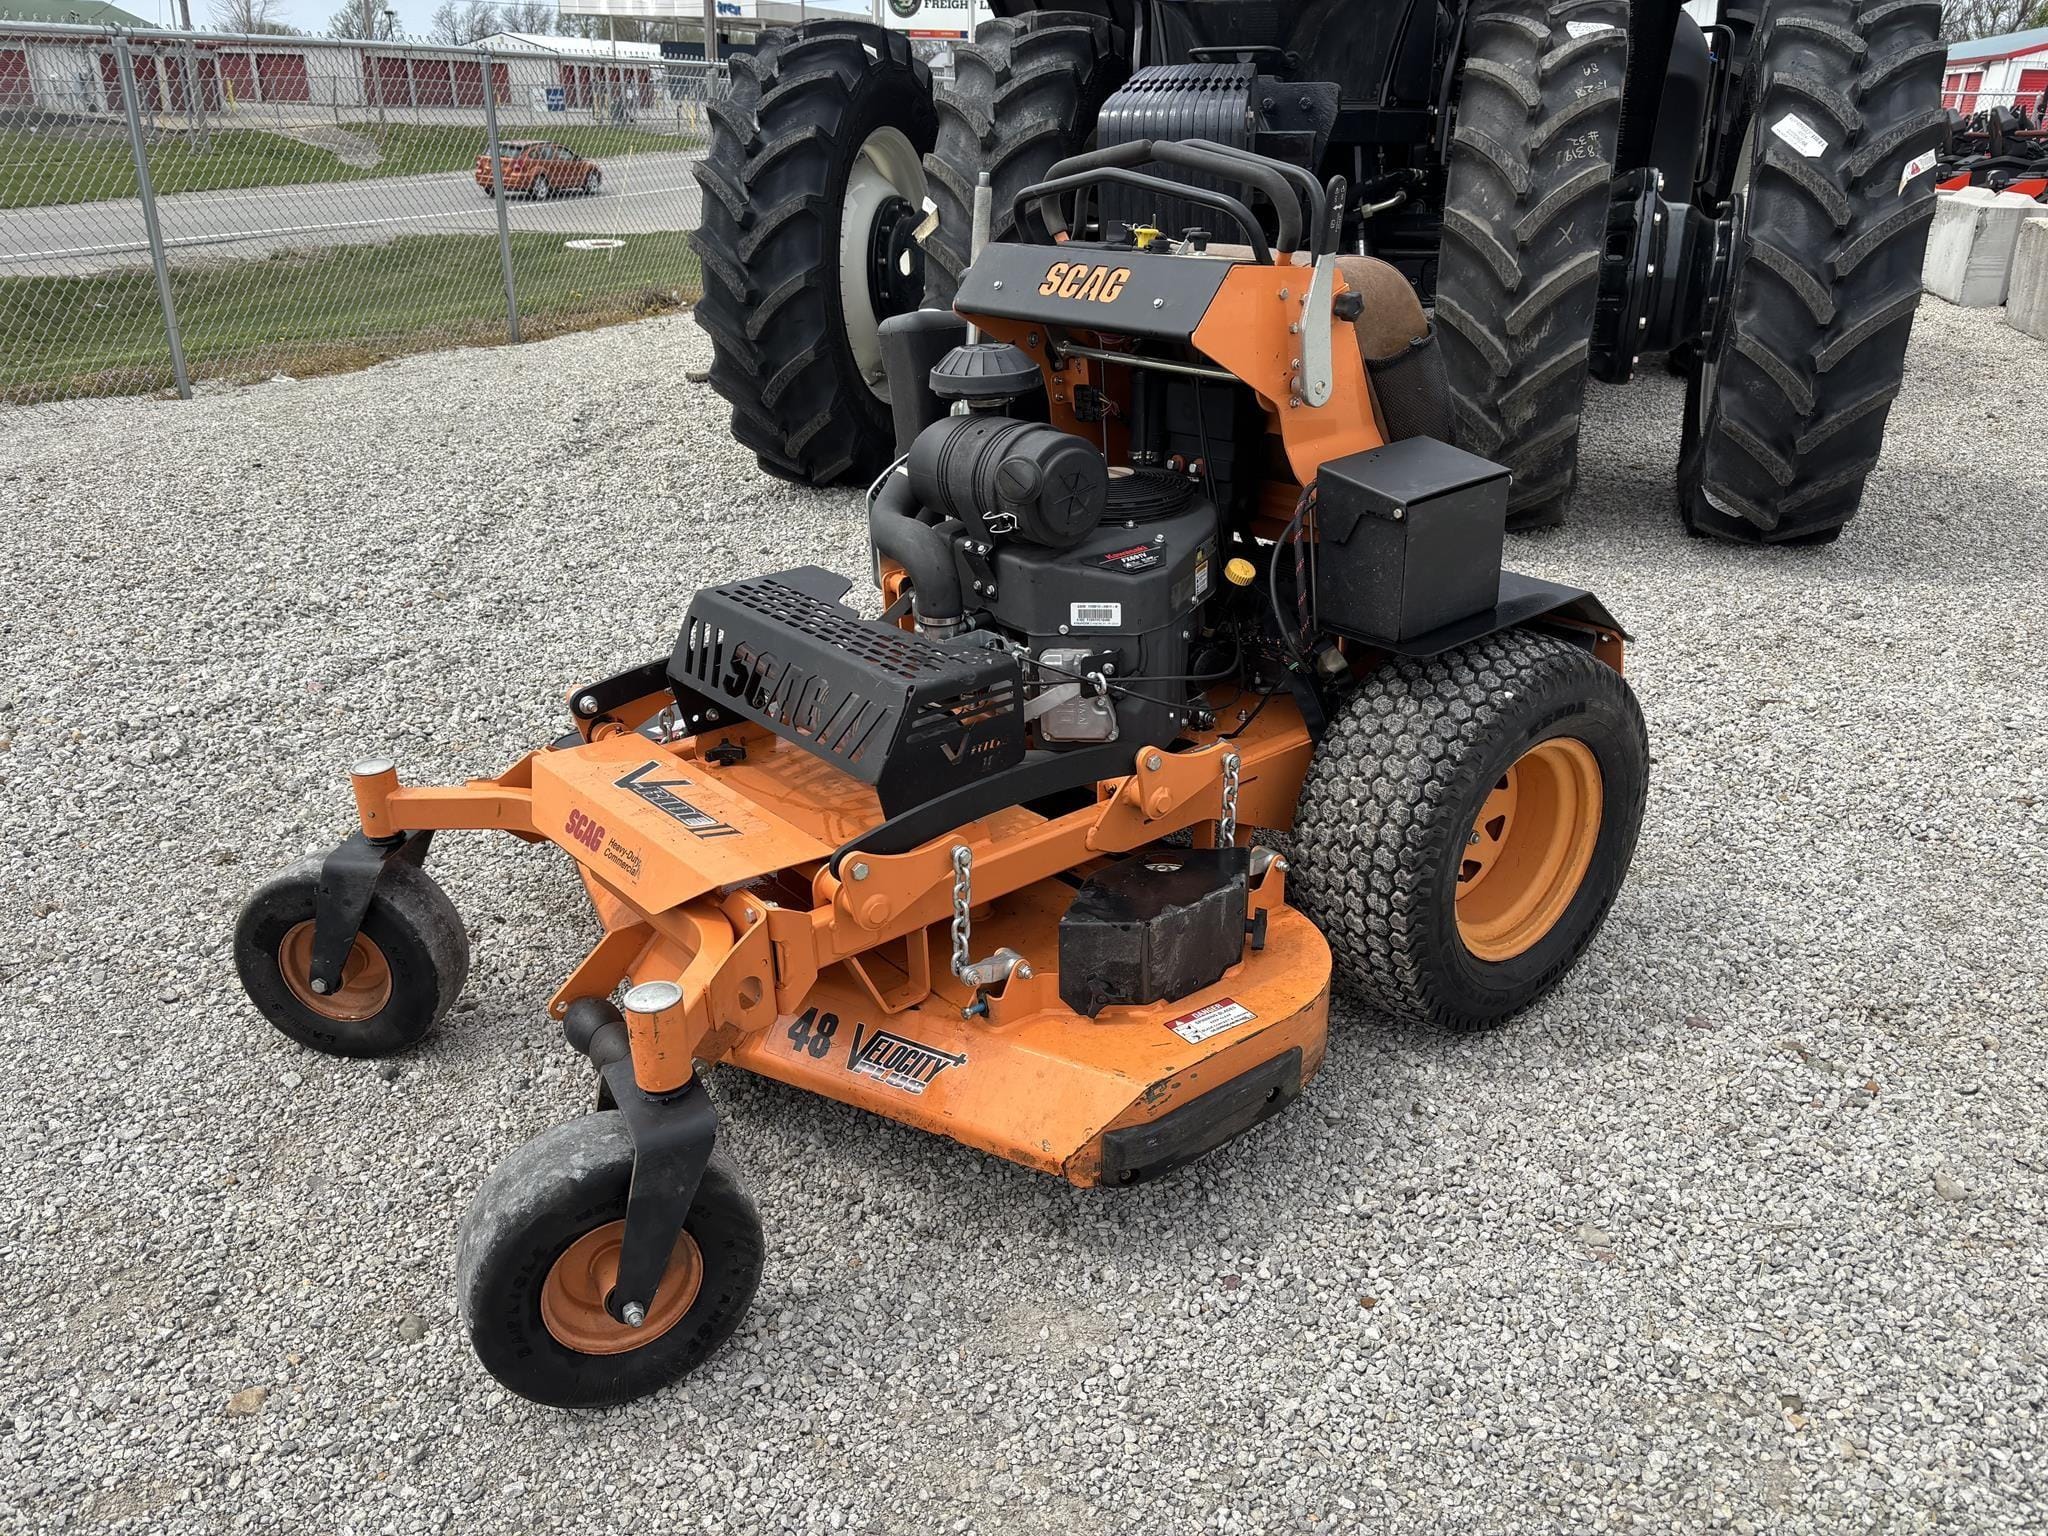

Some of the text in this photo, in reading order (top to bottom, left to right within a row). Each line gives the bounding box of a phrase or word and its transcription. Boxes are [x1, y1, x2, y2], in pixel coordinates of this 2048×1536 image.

[924, 0, 976, 9] FREIGH
[1038, 261, 1131, 303] SCAG
[722, 641, 830, 736] SCAG
[565, 808, 606, 853] SCAG
[603, 849, 638, 877] Commercial
[608, 837, 642, 868] Heavy-Duty
[1191, 1003, 1223, 1019] DANGER
[787, 1006, 840, 1059] 48
[852, 1059, 928, 1096] PLUS
